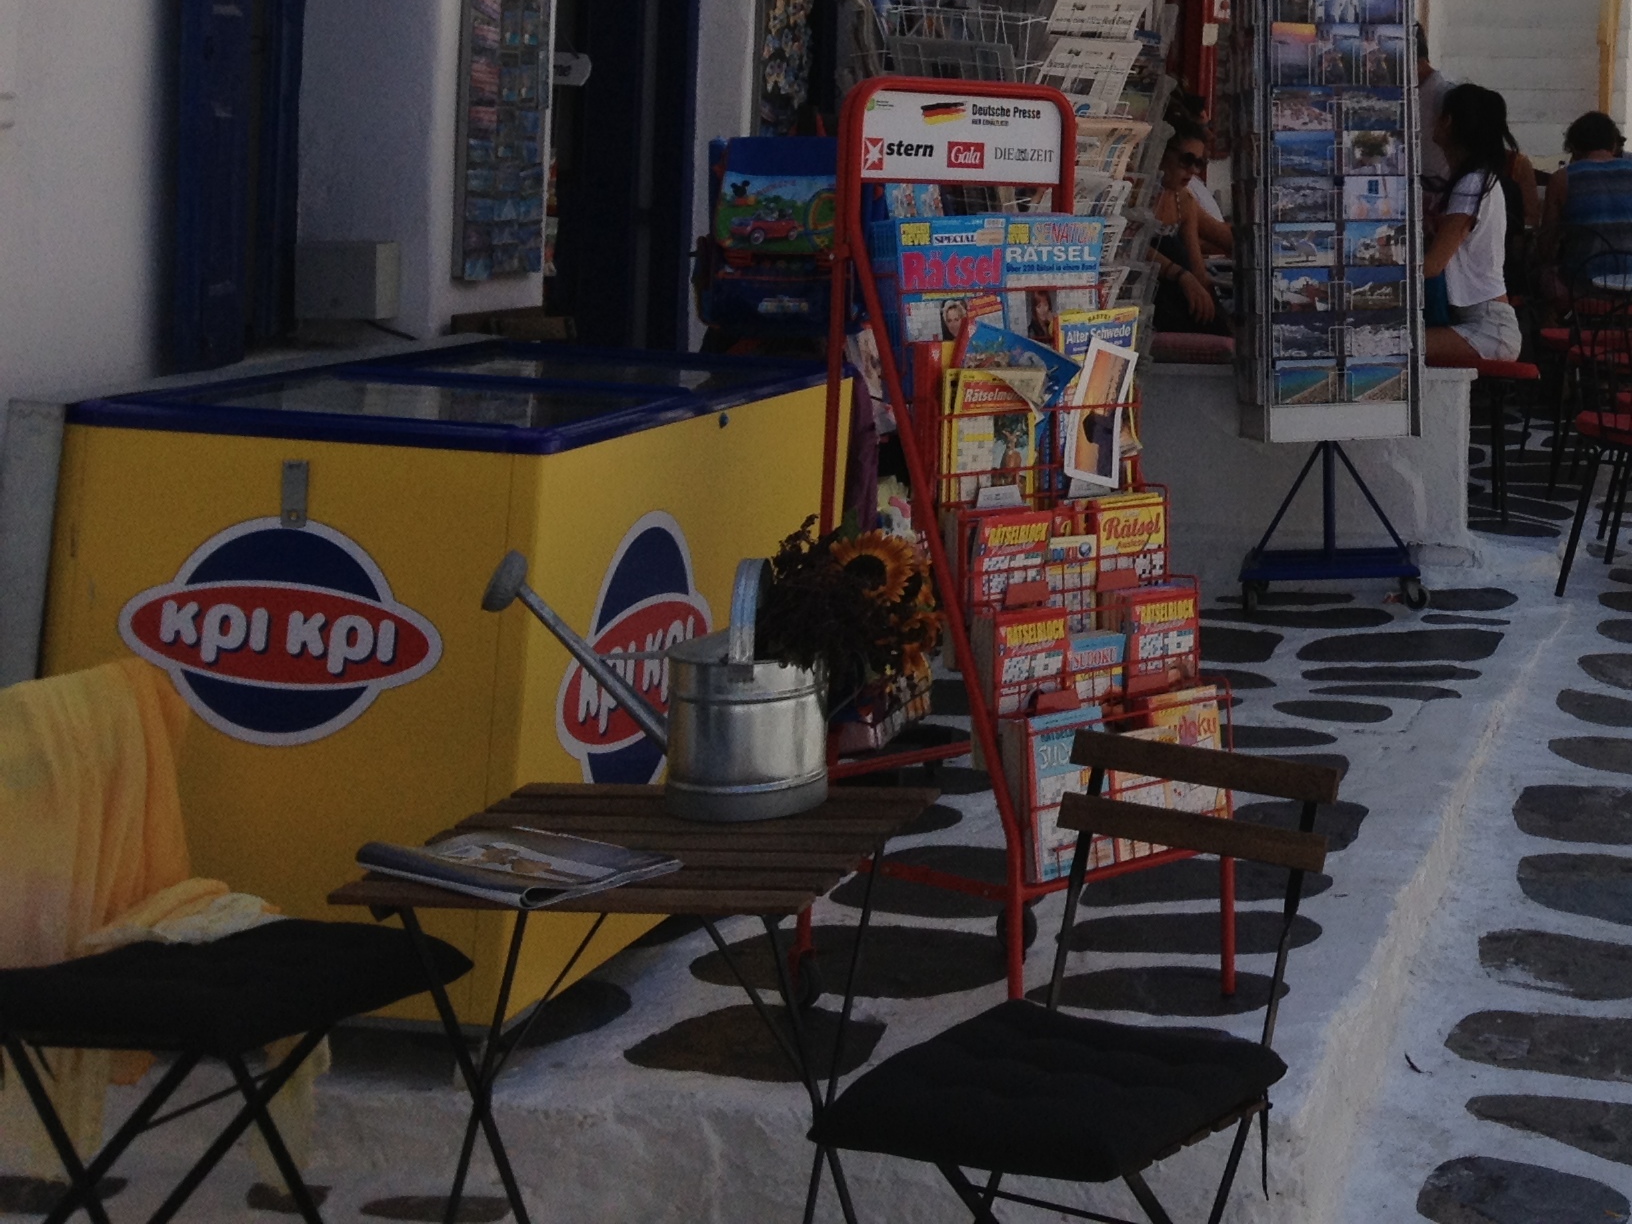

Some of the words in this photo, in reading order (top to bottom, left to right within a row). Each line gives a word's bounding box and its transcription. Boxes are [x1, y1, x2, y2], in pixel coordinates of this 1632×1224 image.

[972, 103, 1011, 118] Deutsche
[1013, 106, 1041, 119] Presse
[886, 140, 934, 158] stern
[950, 145, 981, 164] Gala
[994, 147, 1014, 161] DIE
[1030, 148, 1055, 163] ZEIT
[934, 234, 976, 244] SPECIAL
[1006, 244, 1096, 263] RÄTSEL
[902, 248, 1003, 290] Rätsel
[1065, 329, 1090, 345] Alter
[1090, 323, 1131, 340] Schwede
[1102, 512, 1161, 541] Rätsel
[1072, 647, 1118, 669] SUDOKU
